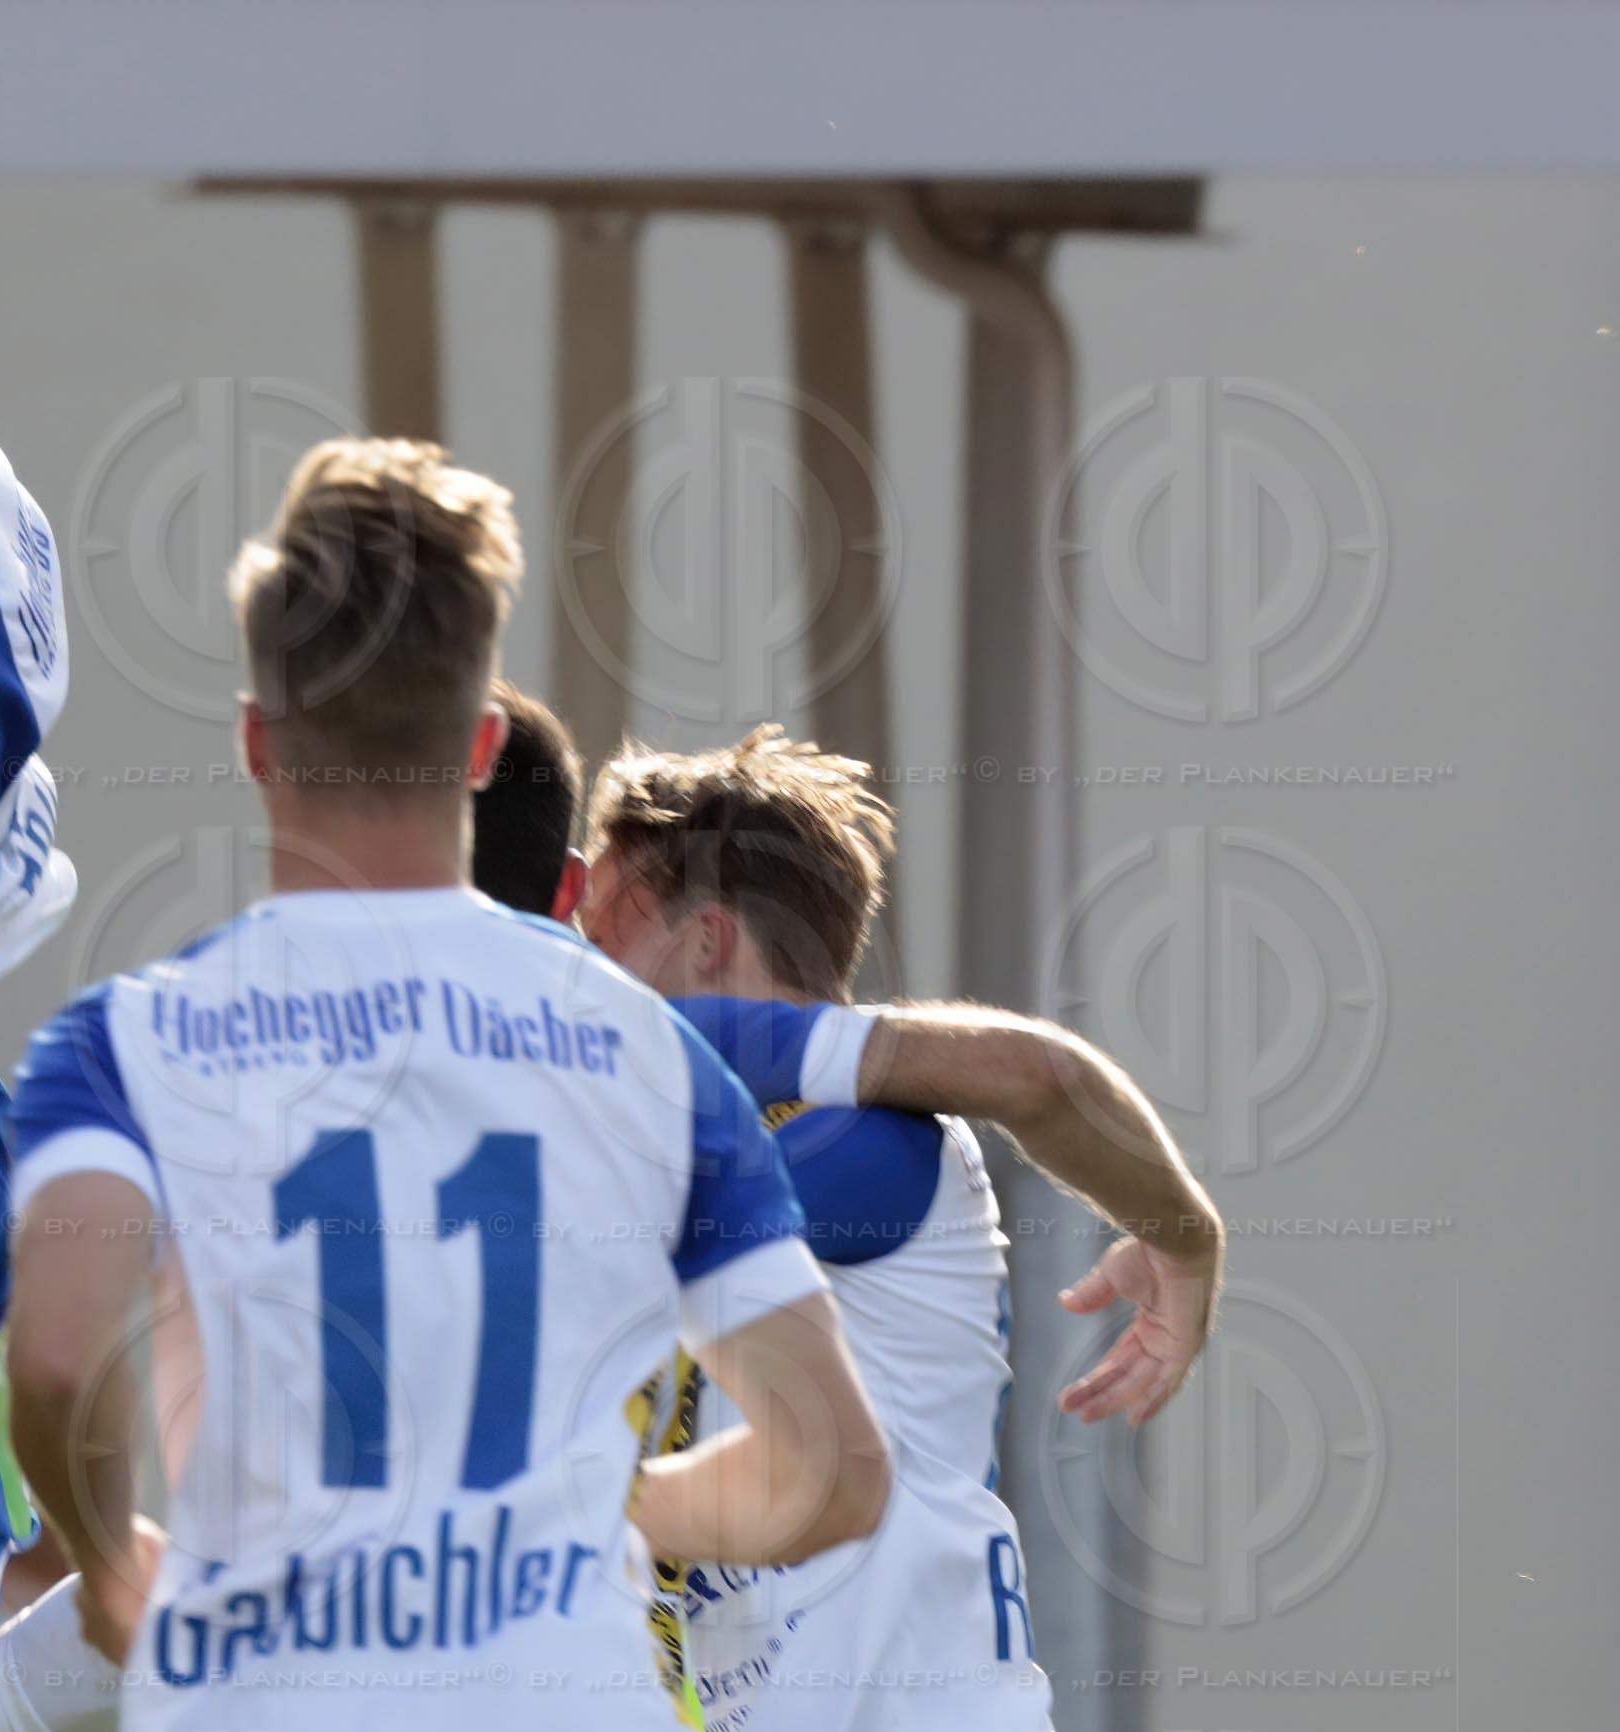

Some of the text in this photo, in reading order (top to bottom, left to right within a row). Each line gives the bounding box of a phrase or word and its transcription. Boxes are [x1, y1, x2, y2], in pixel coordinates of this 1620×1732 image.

[150, 977, 622, 1078] Hochegger Dächer
[272, 1127, 542, 1491] 11
